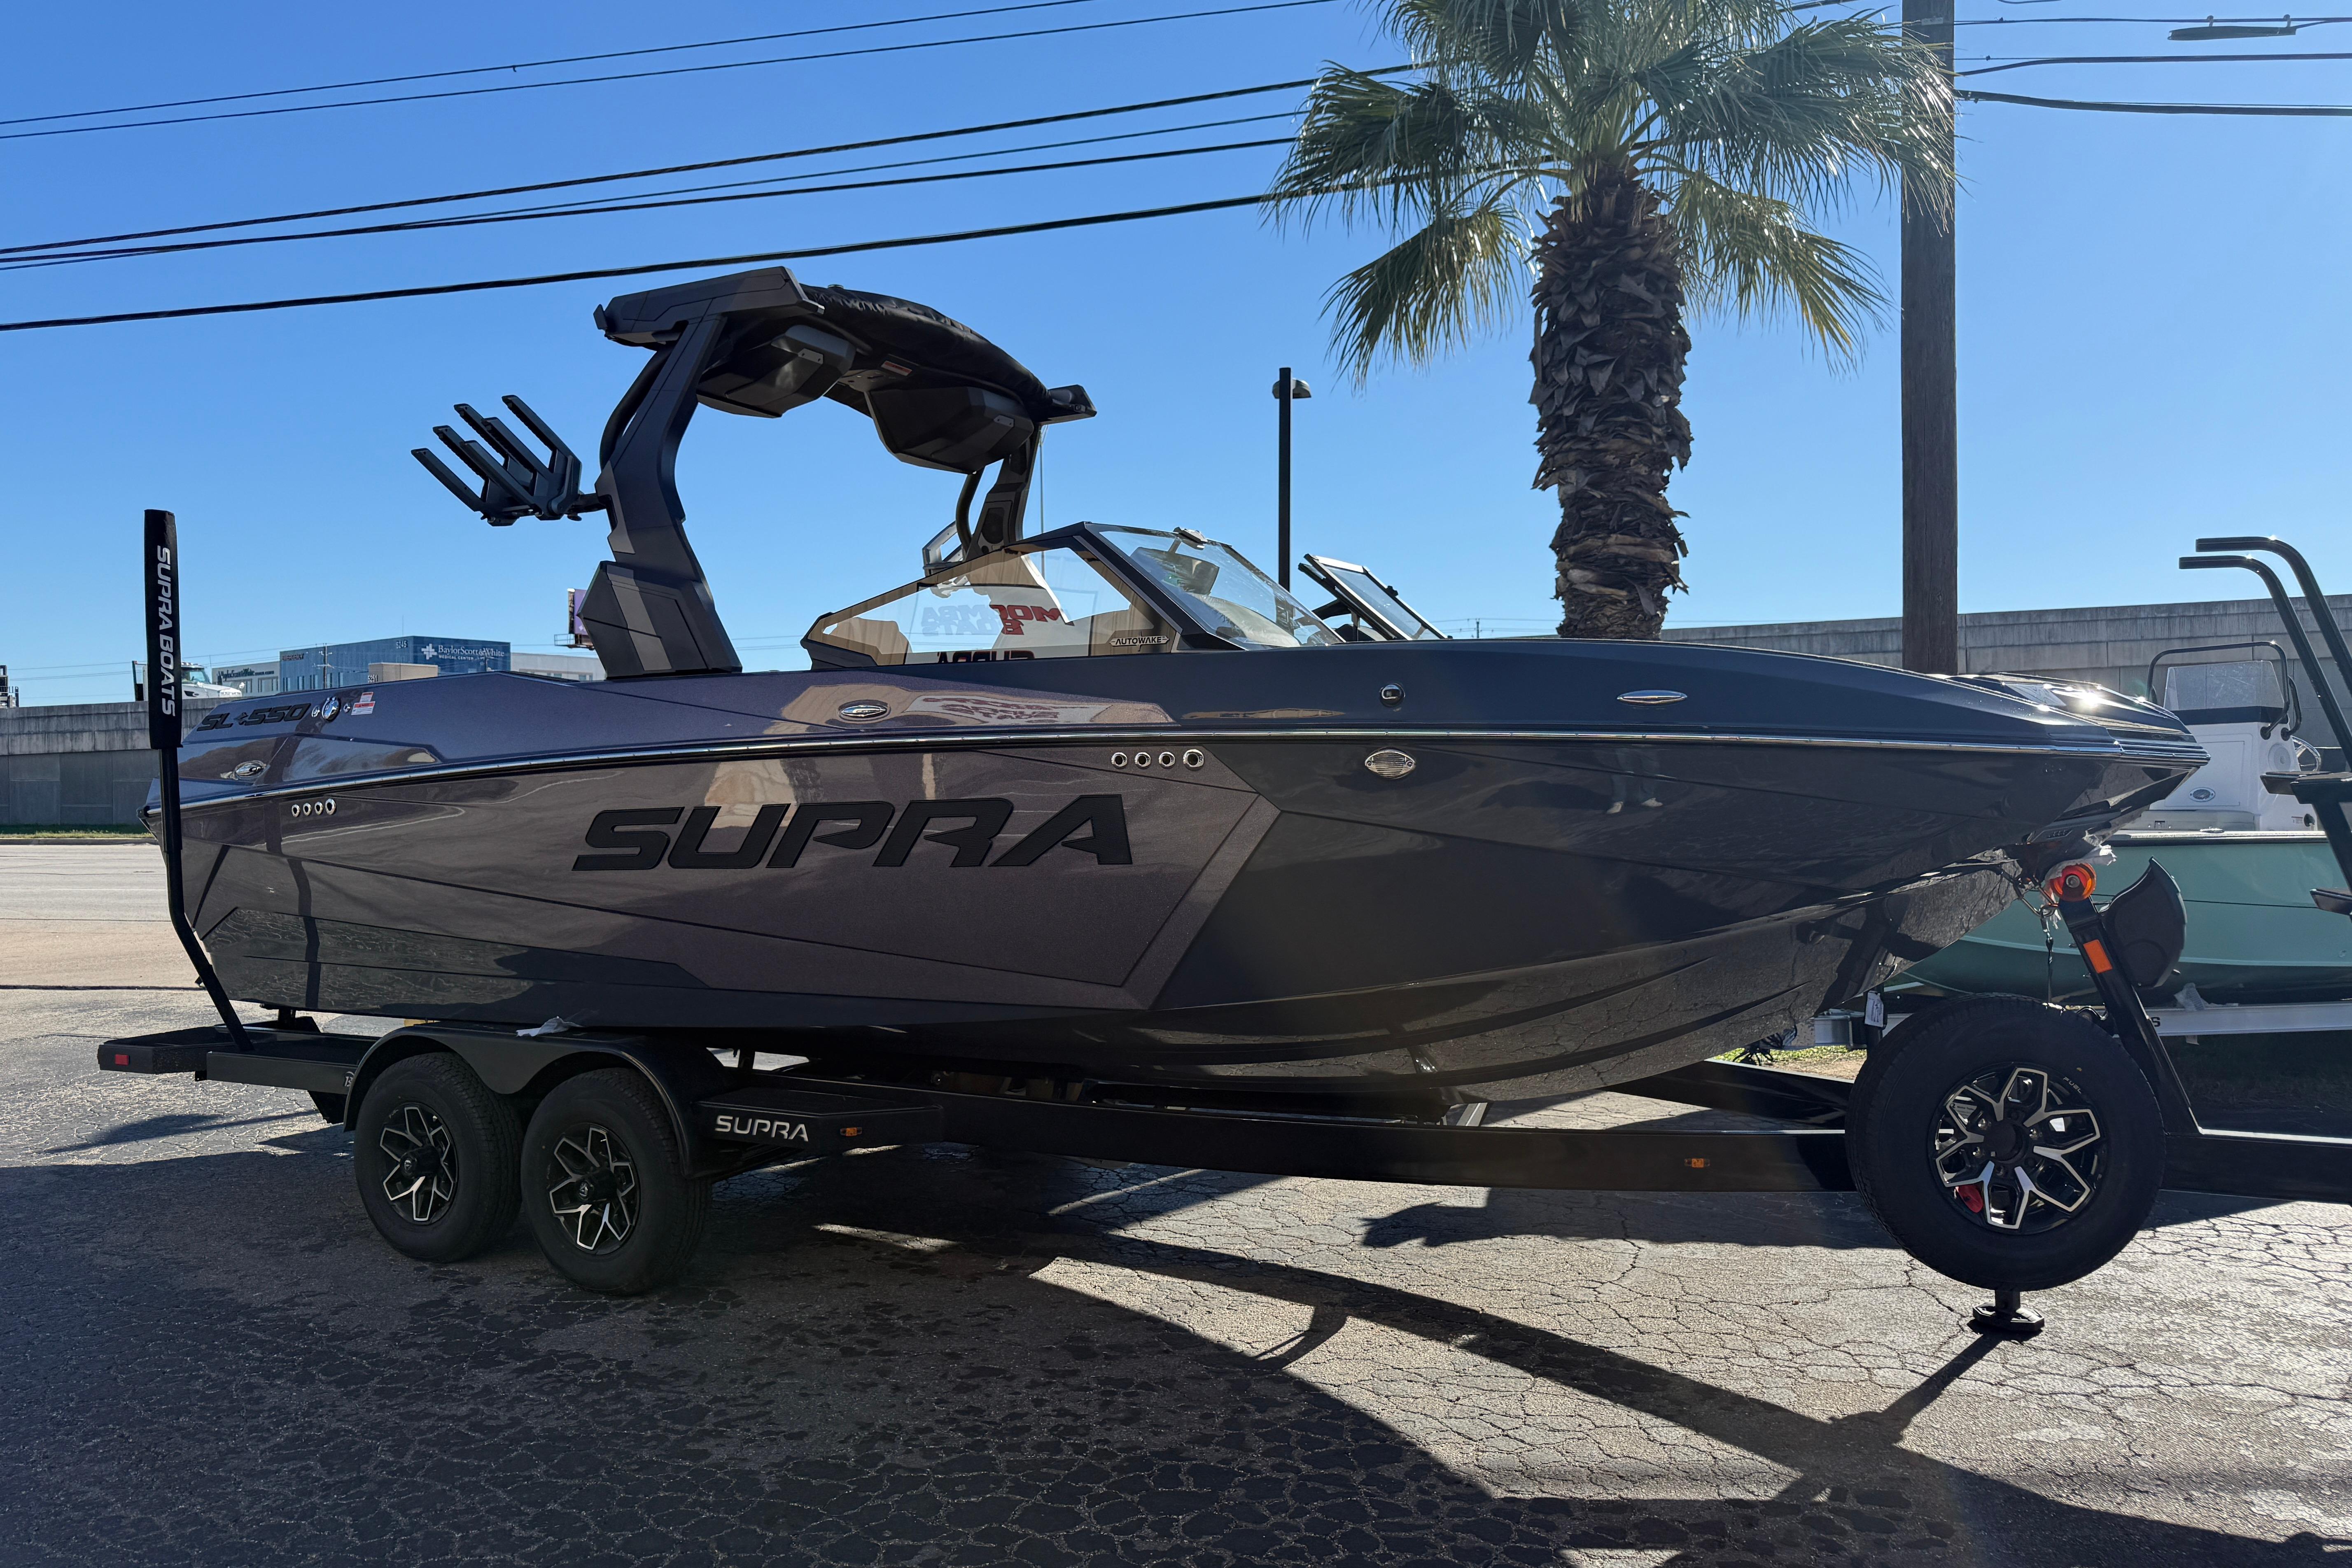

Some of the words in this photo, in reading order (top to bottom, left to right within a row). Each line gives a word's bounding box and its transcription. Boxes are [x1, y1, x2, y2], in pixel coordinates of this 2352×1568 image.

[157, 545, 173, 630] SUPRA
[1115, 637, 1162, 645] AUTOWAKE
[159, 634, 175, 716] BOATS
[196, 712, 233, 731] SL
[244, 703, 311, 726] 550
[572, 794, 1133, 871] SUPRA
[2063, 1077, 2081, 1094] FUEL
[714, 1115, 809, 1142] SUPRA
